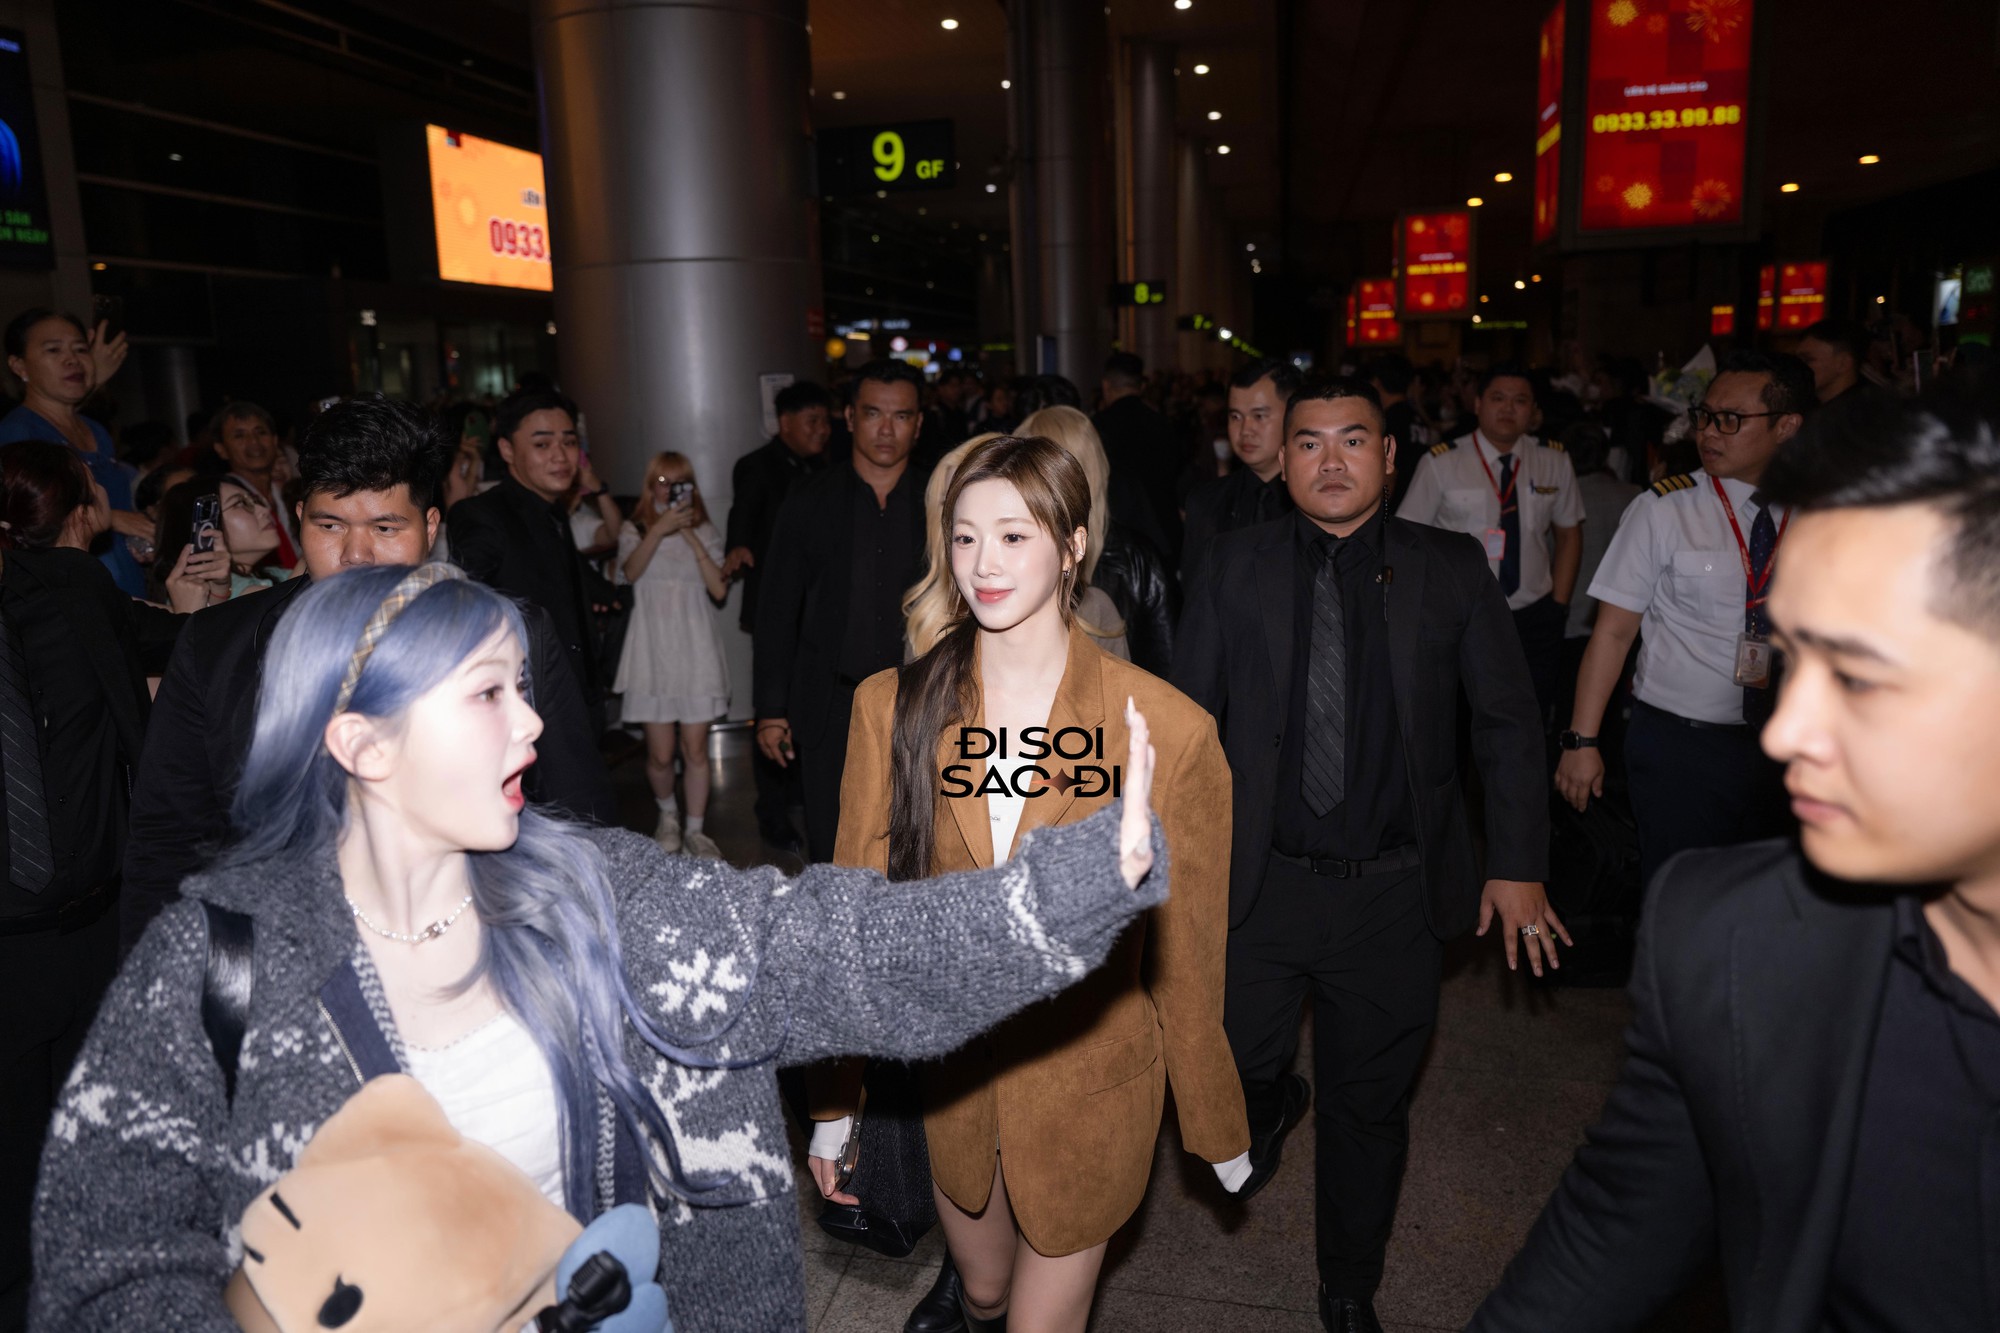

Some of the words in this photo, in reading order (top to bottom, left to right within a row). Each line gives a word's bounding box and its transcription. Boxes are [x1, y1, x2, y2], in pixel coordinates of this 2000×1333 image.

[872, 130, 905, 181] 9
[915, 159, 945, 180] GF
[1134, 282, 1150, 304] 8
